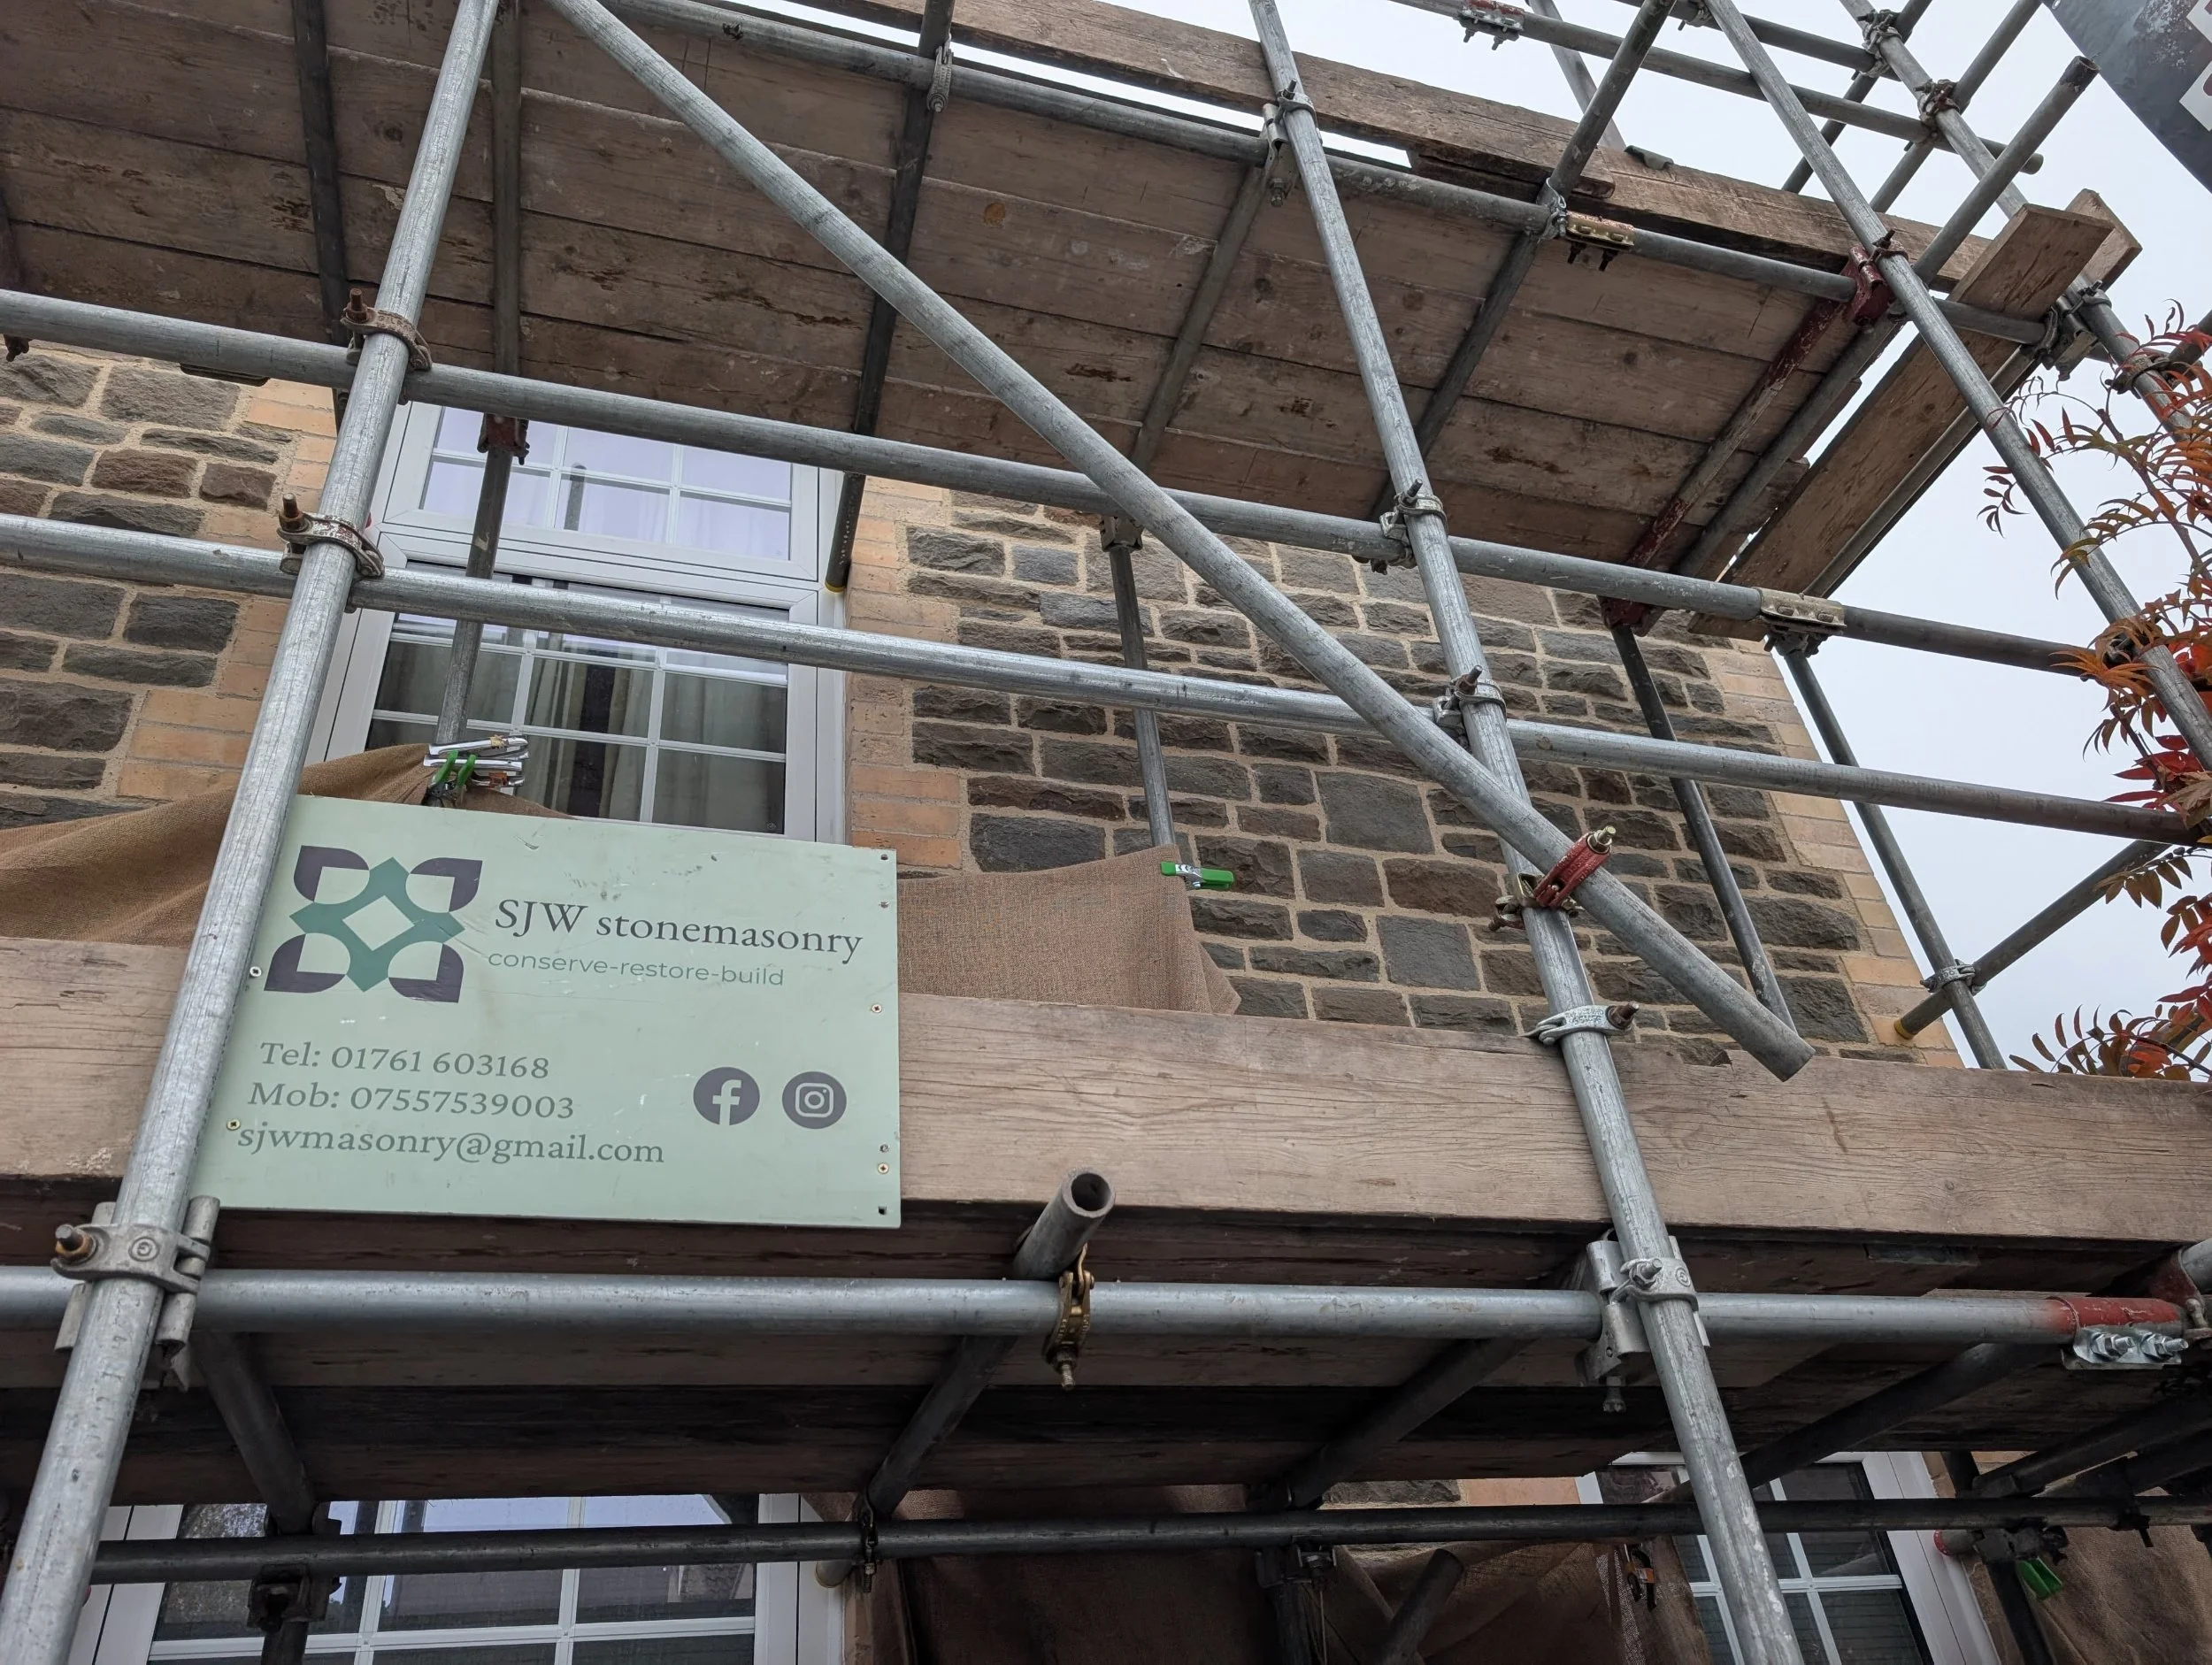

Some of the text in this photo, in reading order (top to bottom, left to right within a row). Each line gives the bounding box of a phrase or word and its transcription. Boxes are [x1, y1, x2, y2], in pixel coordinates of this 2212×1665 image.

[495, 899, 864, 965] SJW stonemasonry
[488, 953, 785, 986] conserve-restore-build
[260, 1040, 550, 1079] Tel: 01761 603168
[247, 1081, 574, 1120] Mob: 07557539003
[237, 1120, 664, 1164] sjwmasonry@gmail.com
